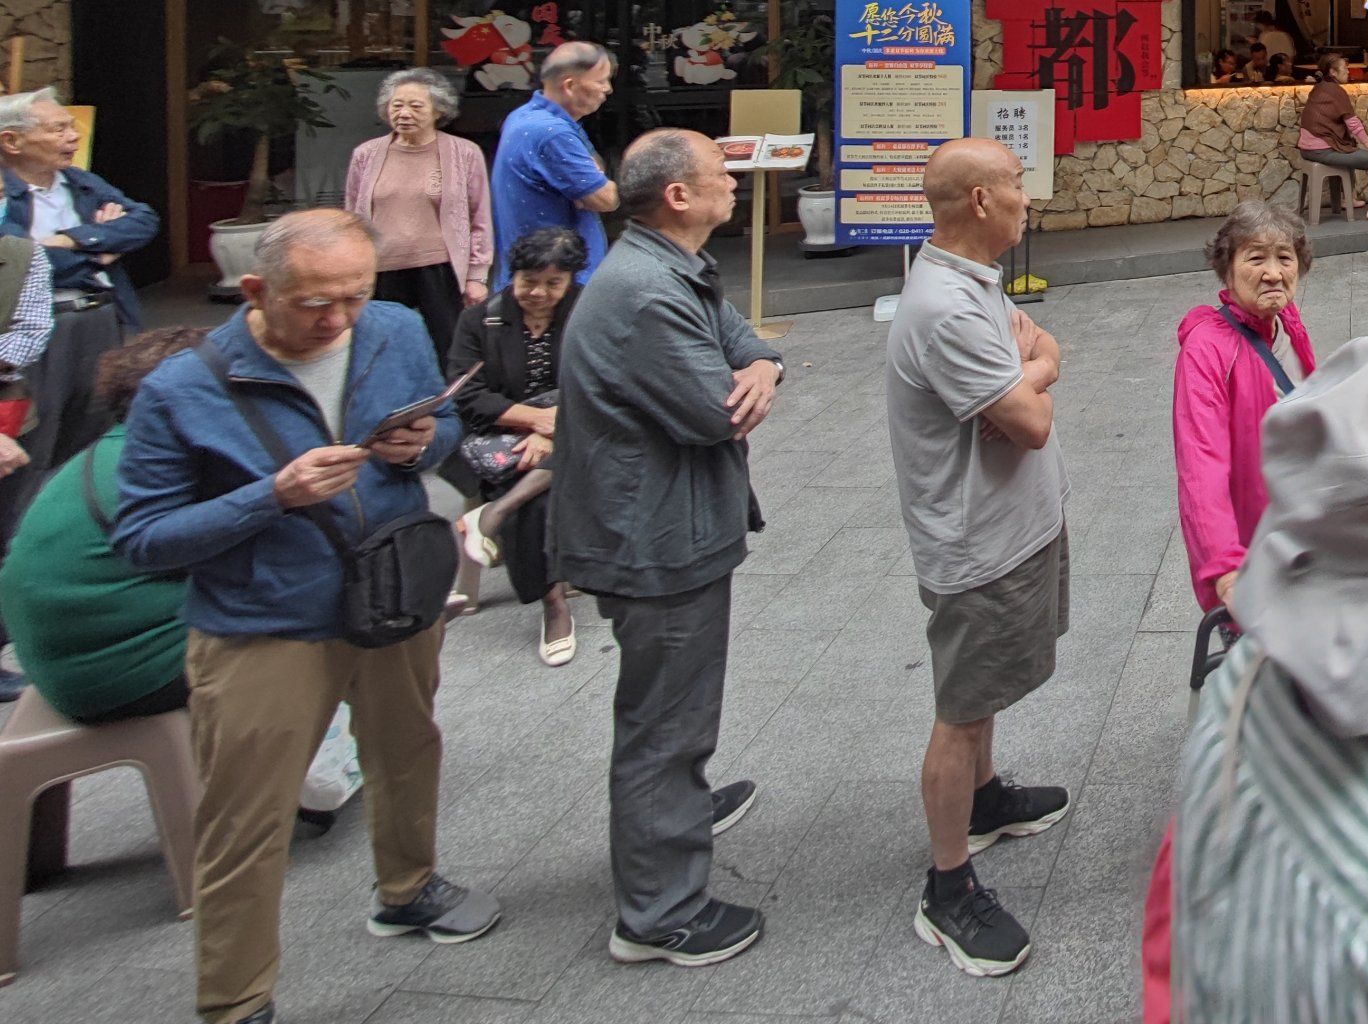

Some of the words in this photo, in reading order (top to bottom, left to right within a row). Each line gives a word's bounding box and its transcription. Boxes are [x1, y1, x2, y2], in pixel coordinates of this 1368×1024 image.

[858, 2, 948, 29] 愿您今秋
[643, 22, 679, 53] 中秋
[997, 107, 1027, 120] 招聘
